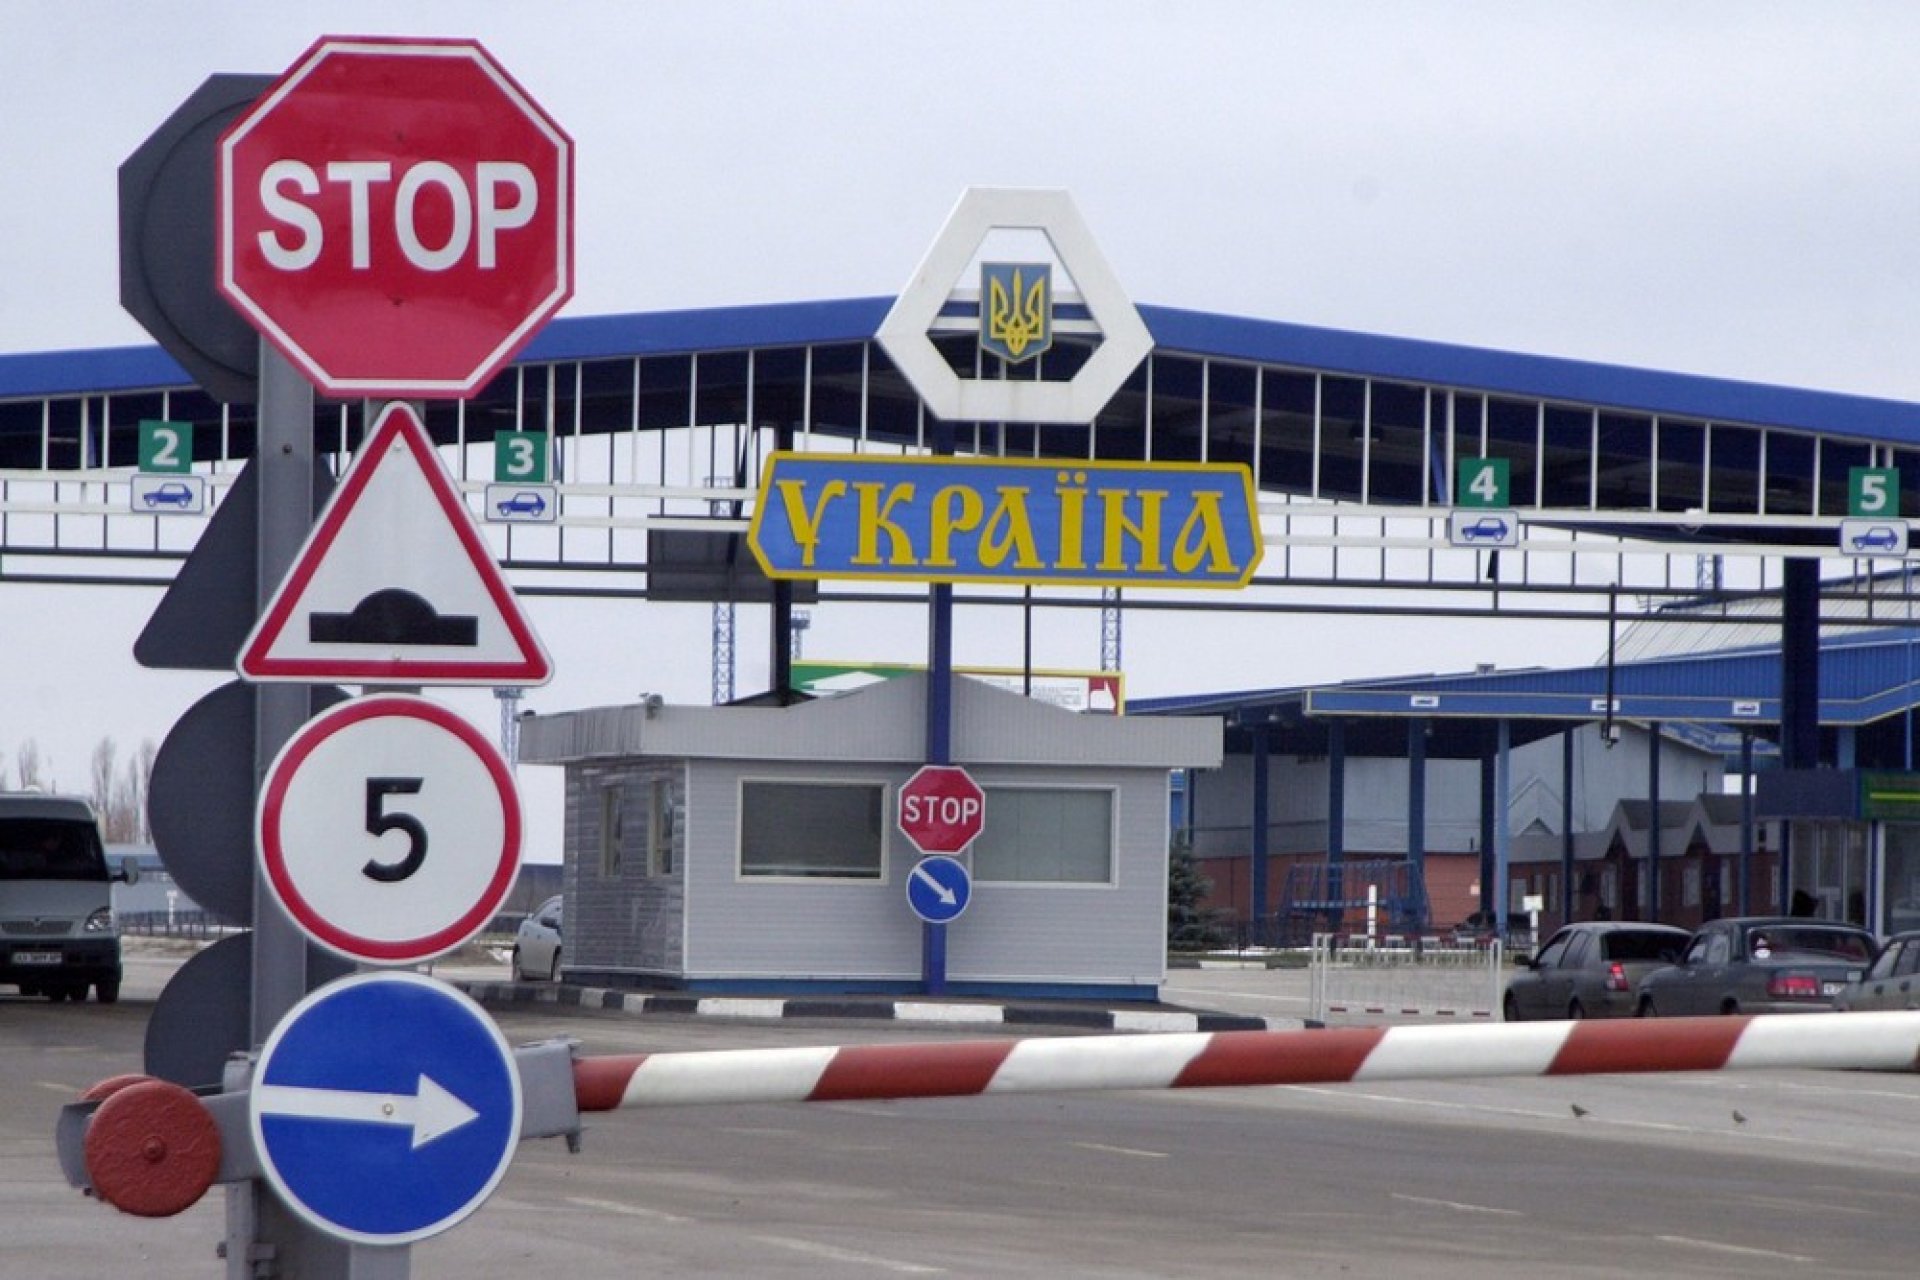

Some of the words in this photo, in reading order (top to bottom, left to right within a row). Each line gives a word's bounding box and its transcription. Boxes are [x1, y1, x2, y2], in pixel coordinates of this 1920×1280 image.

[258, 160, 538, 271] STOP
[151, 428, 180, 467] 2
[506, 437, 535, 475] 3
[1469, 465, 1499, 502] 4
[1860, 475, 1887, 512] 5
[777, 472, 1239, 574] УКРАЇНА
[904, 795, 980, 825] STOP
[362, 777, 429, 883] 5
